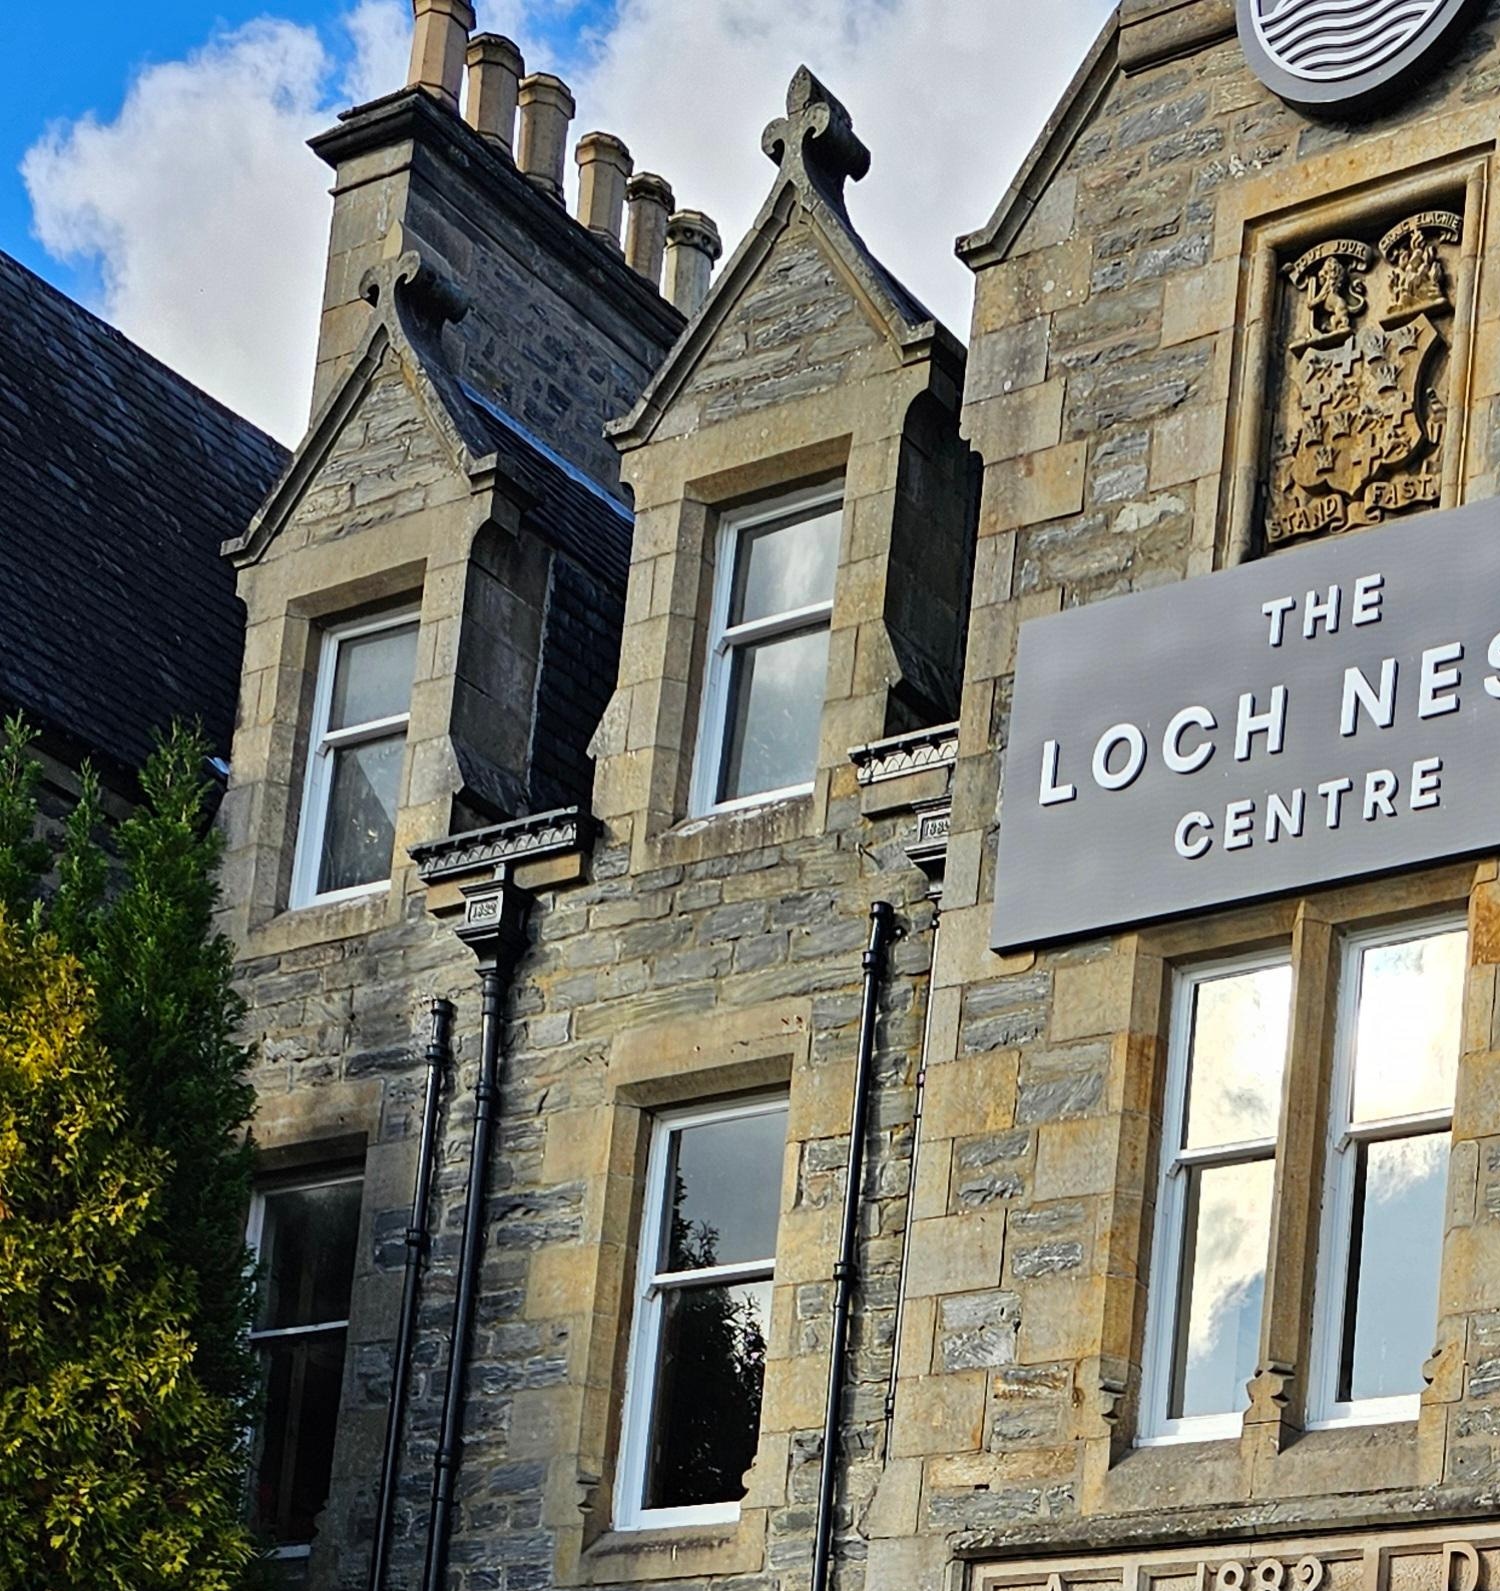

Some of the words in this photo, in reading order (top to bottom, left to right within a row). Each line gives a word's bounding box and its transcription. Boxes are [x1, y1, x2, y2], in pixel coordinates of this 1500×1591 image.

[1269, 497, 1338, 539] STAND
[1372, 478, 1436, 505] FAST.
[1262, 574, 1385, 646] THE
[1039, 685, 1287, 806] LOCH
[1174, 757, 1443, 859] CENTRE
